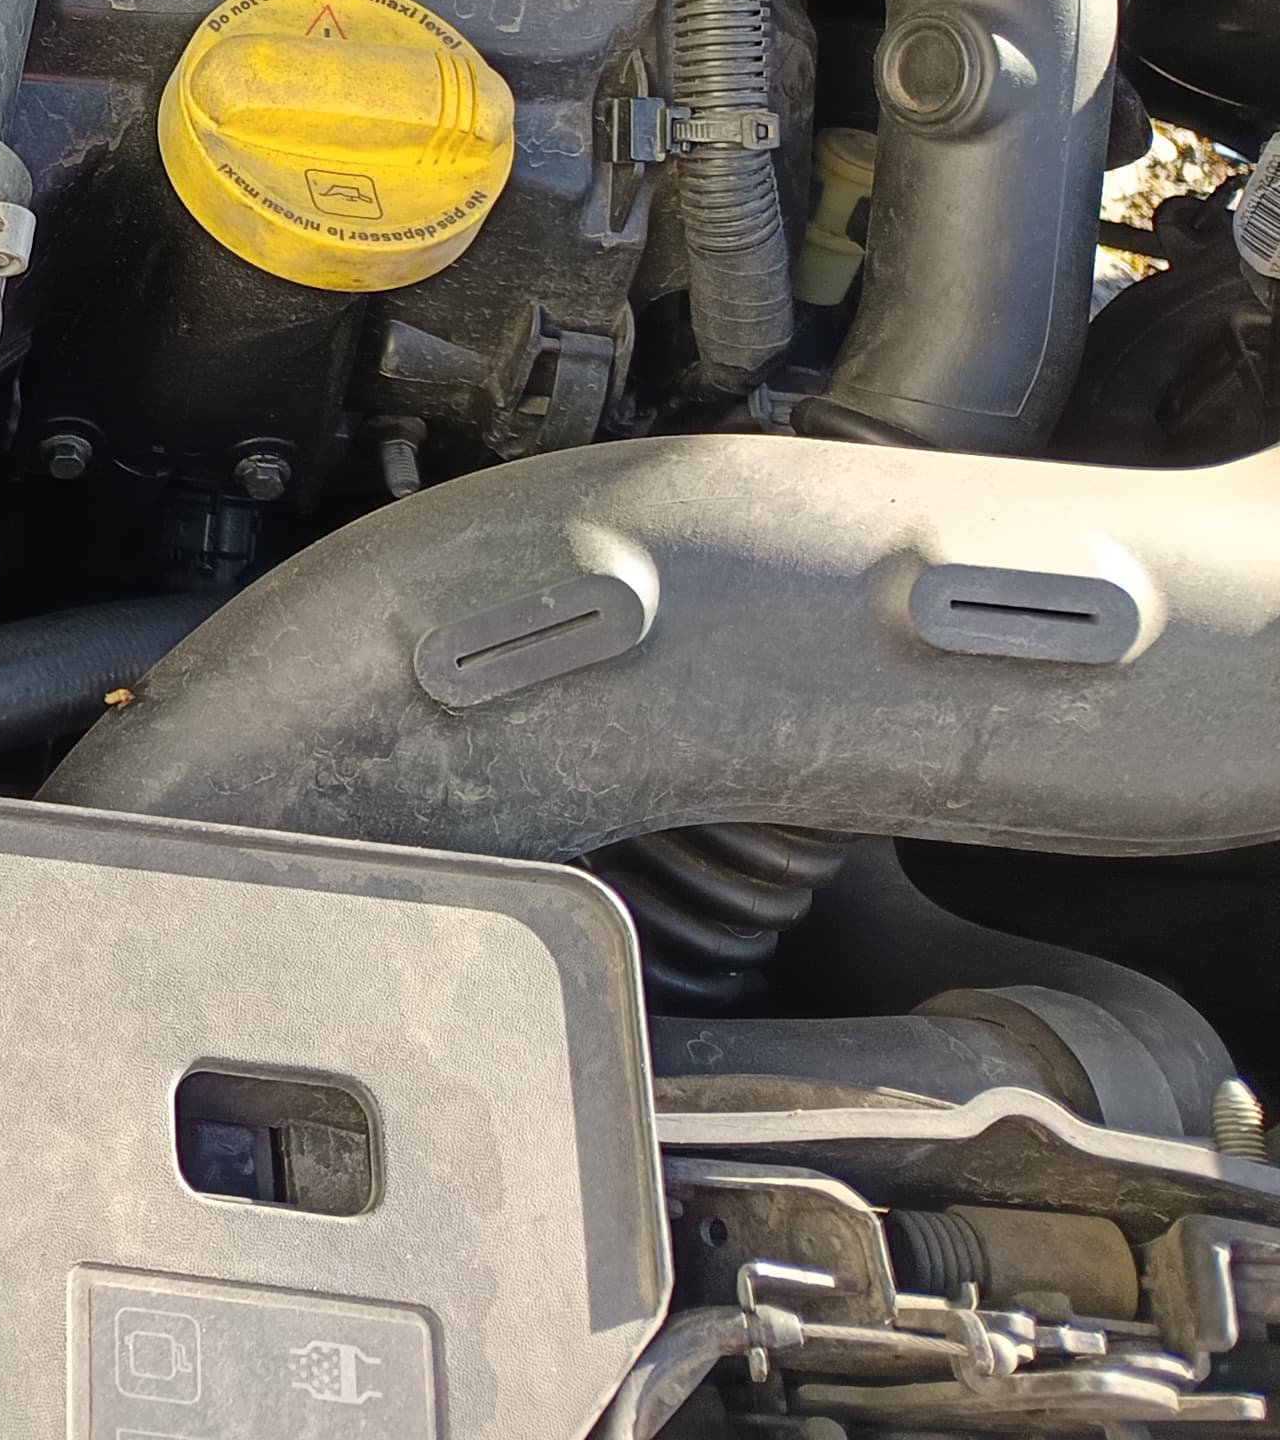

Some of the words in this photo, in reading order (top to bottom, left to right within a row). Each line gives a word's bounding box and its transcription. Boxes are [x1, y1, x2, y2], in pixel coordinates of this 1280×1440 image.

[207, 15, 230, 33] Do
[418, 13, 462, 51] level
[218, 162, 261, 198] maxi
[467, 190, 488, 210] Ne
[262, 195, 321, 233] niveau
[439, 208, 469, 231] pas
[327, 225, 345, 243] le
[348, 222, 437, 242] dépasser
